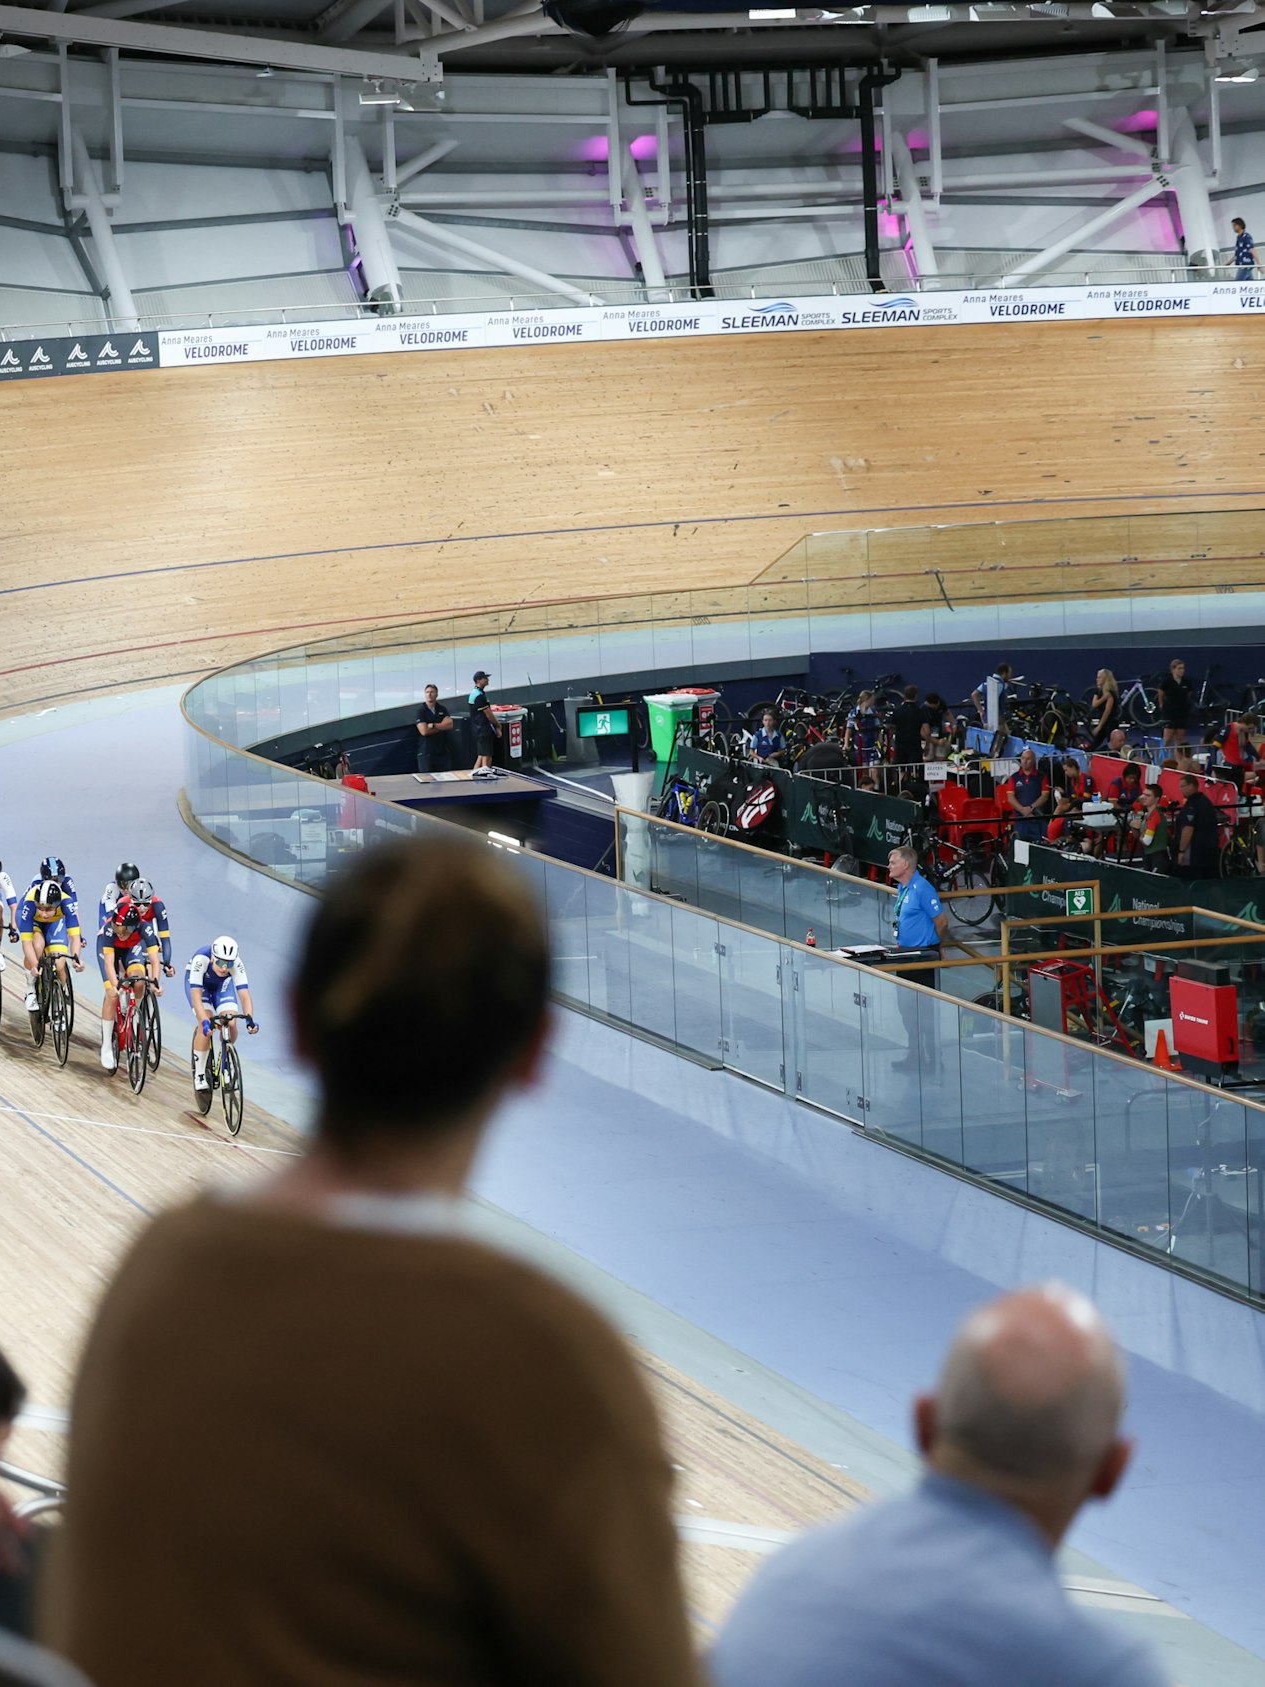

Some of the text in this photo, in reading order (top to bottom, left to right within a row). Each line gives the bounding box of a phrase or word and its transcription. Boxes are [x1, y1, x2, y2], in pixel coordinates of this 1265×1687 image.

[1087, 290, 1148, 299] Anna Meares
[1213, 287, 1237, 295] Anna
[963, 294, 1024, 303] Anna Meares
[989, 303, 1066, 316] VELODROME
[1114, 299, 1191, 312] VELODROME
[488, 316, 544, 326] Anna Meares
[603, 310, 661, 320] Anna Meares
[721, 314, 799, 329] SLEEMAN
[841, 309, 921, 324] SLEEMAN
[375, 321, 431, 332] Anna Meares
[513, 324, 583, 339] VELODROME
[628, 318, 700, 333] VELODROME
[161, 334, 213, 345] Anna Meares
[266, 328, 320, 339] Anna Meares
[400, 330, 469, 345] VELODROME
[290, 336, 357, 352] VELODROME
[184, 343, 249, 359] VELODROME
[105, 890, 113, 901] VIC
[66, 902, 77, 916] ACT
[1132, 897, 1160, 910] National
[21, 905, 30, 921] ACT
[193, 961, 203, 973] VIC
[237, 962, 245, 974] VIC
